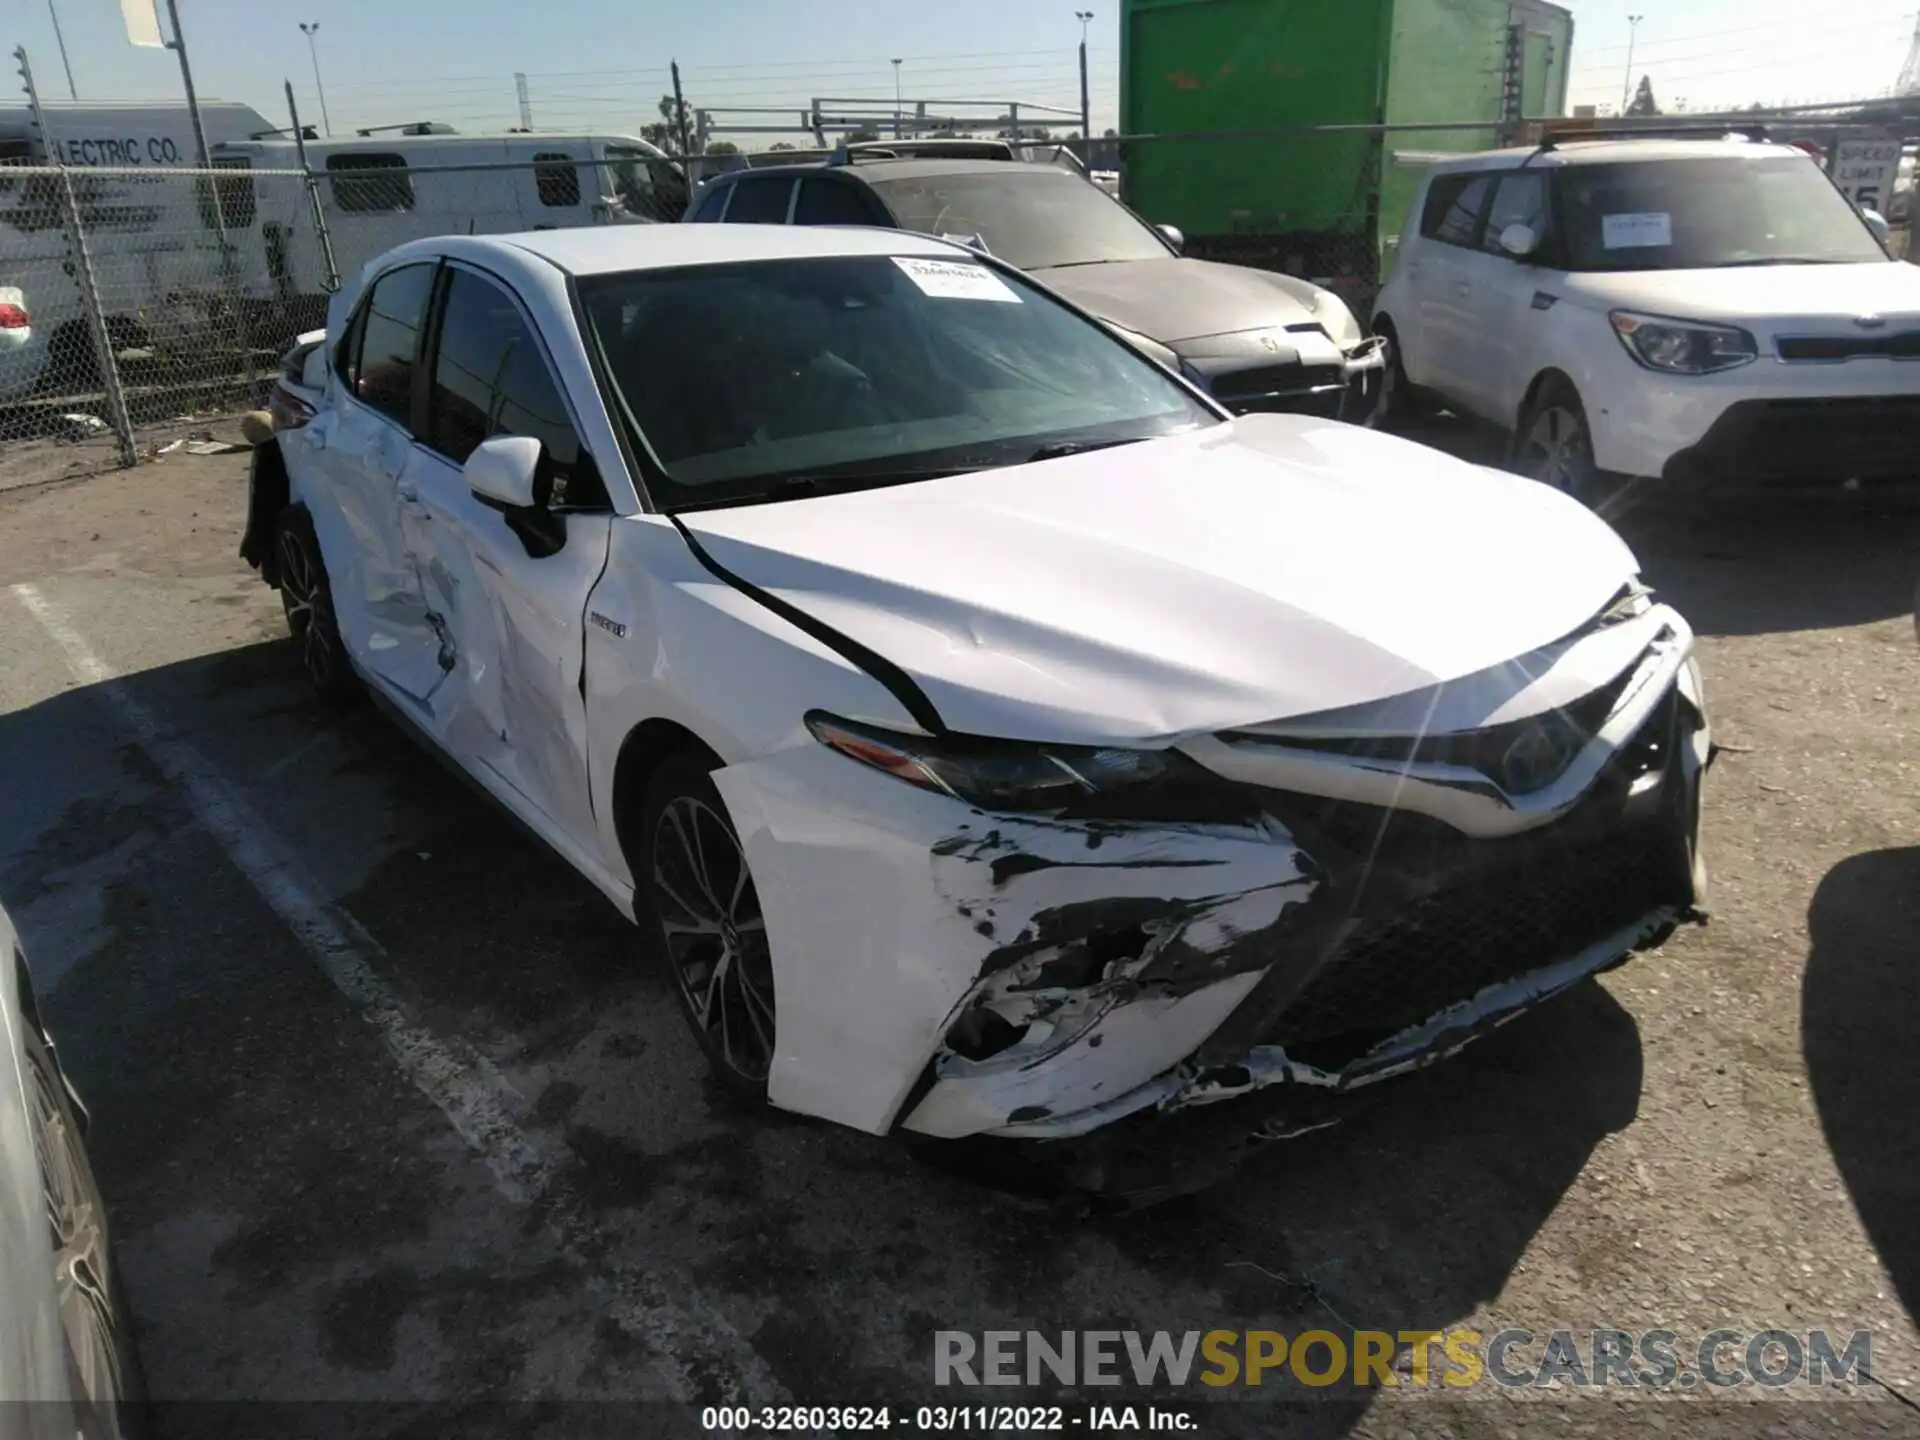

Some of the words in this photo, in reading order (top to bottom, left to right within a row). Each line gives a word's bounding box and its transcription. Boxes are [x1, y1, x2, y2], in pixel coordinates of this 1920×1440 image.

[51, 138, 142, 166] LECTRIC
[148, 137, 183, 163] CO.
[1840, 146, 1896, 161] SPEED
[1841, 166, 1885, 179] LIMIT
